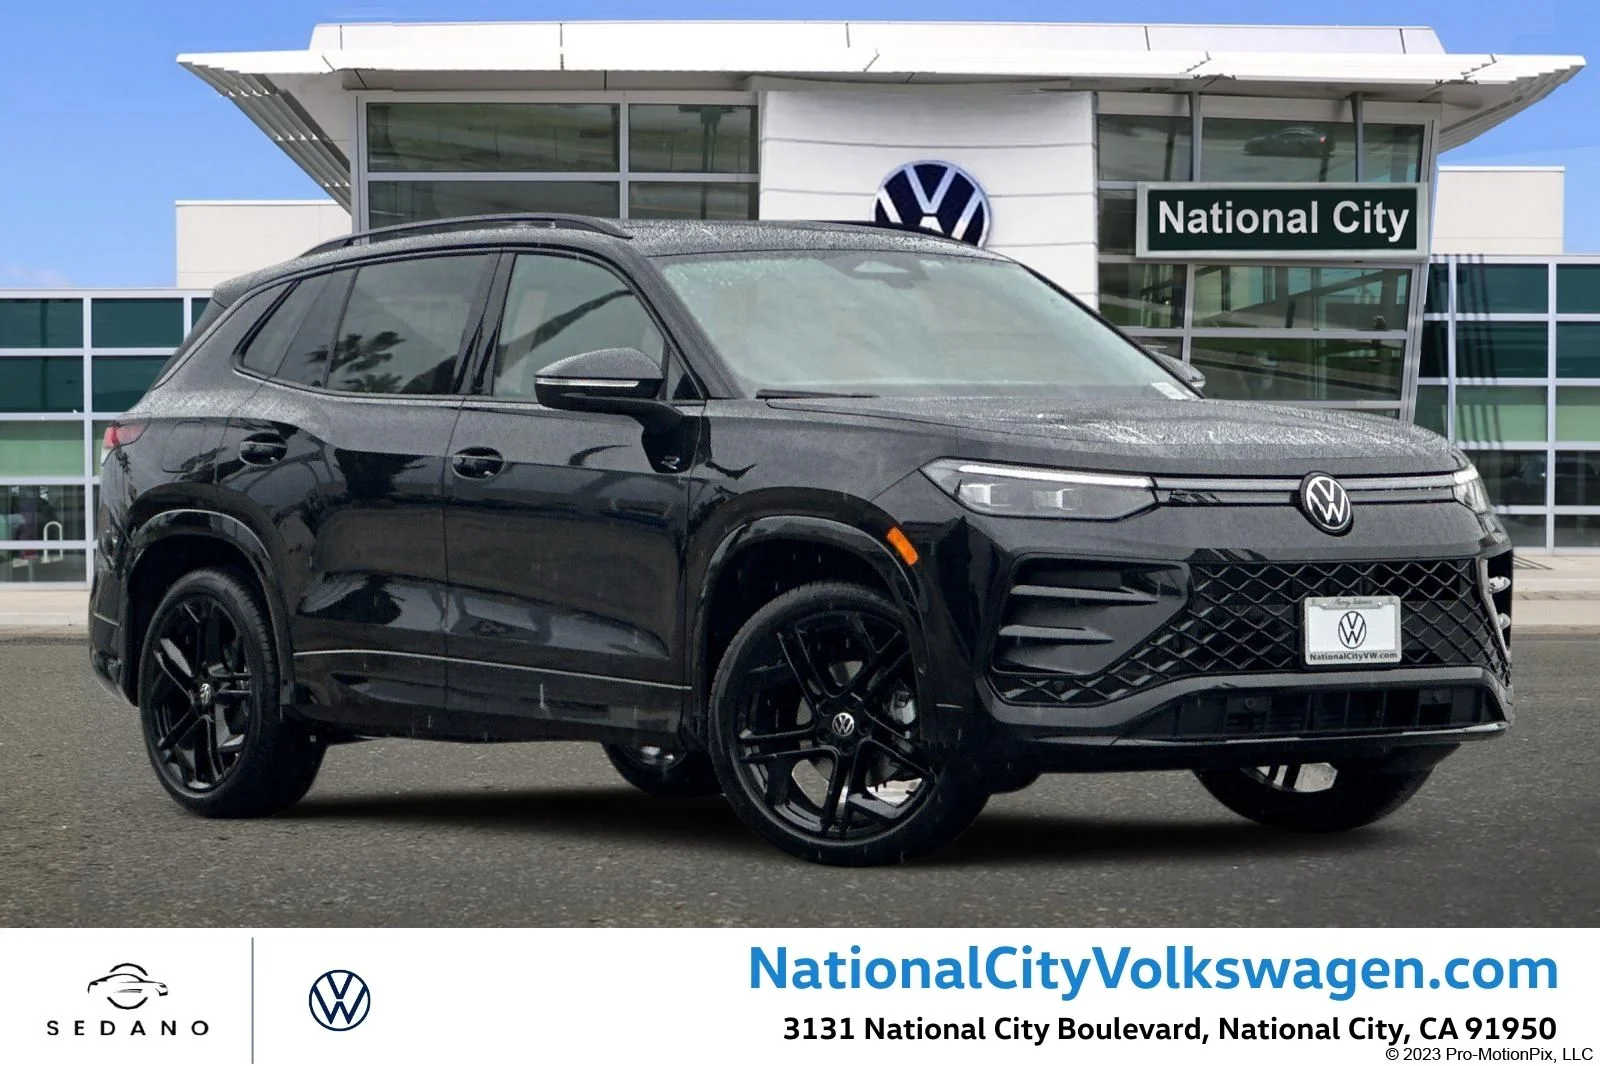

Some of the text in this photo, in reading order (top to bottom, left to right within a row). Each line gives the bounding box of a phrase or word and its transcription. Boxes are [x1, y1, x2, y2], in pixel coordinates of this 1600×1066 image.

[1158, 200, 1410, 243] National City
[1305, 475, 1351, 530] VW
[1338, 610, 1367, 649] VW
[1309, 651, 1398, 661] NationalCityVW.com
